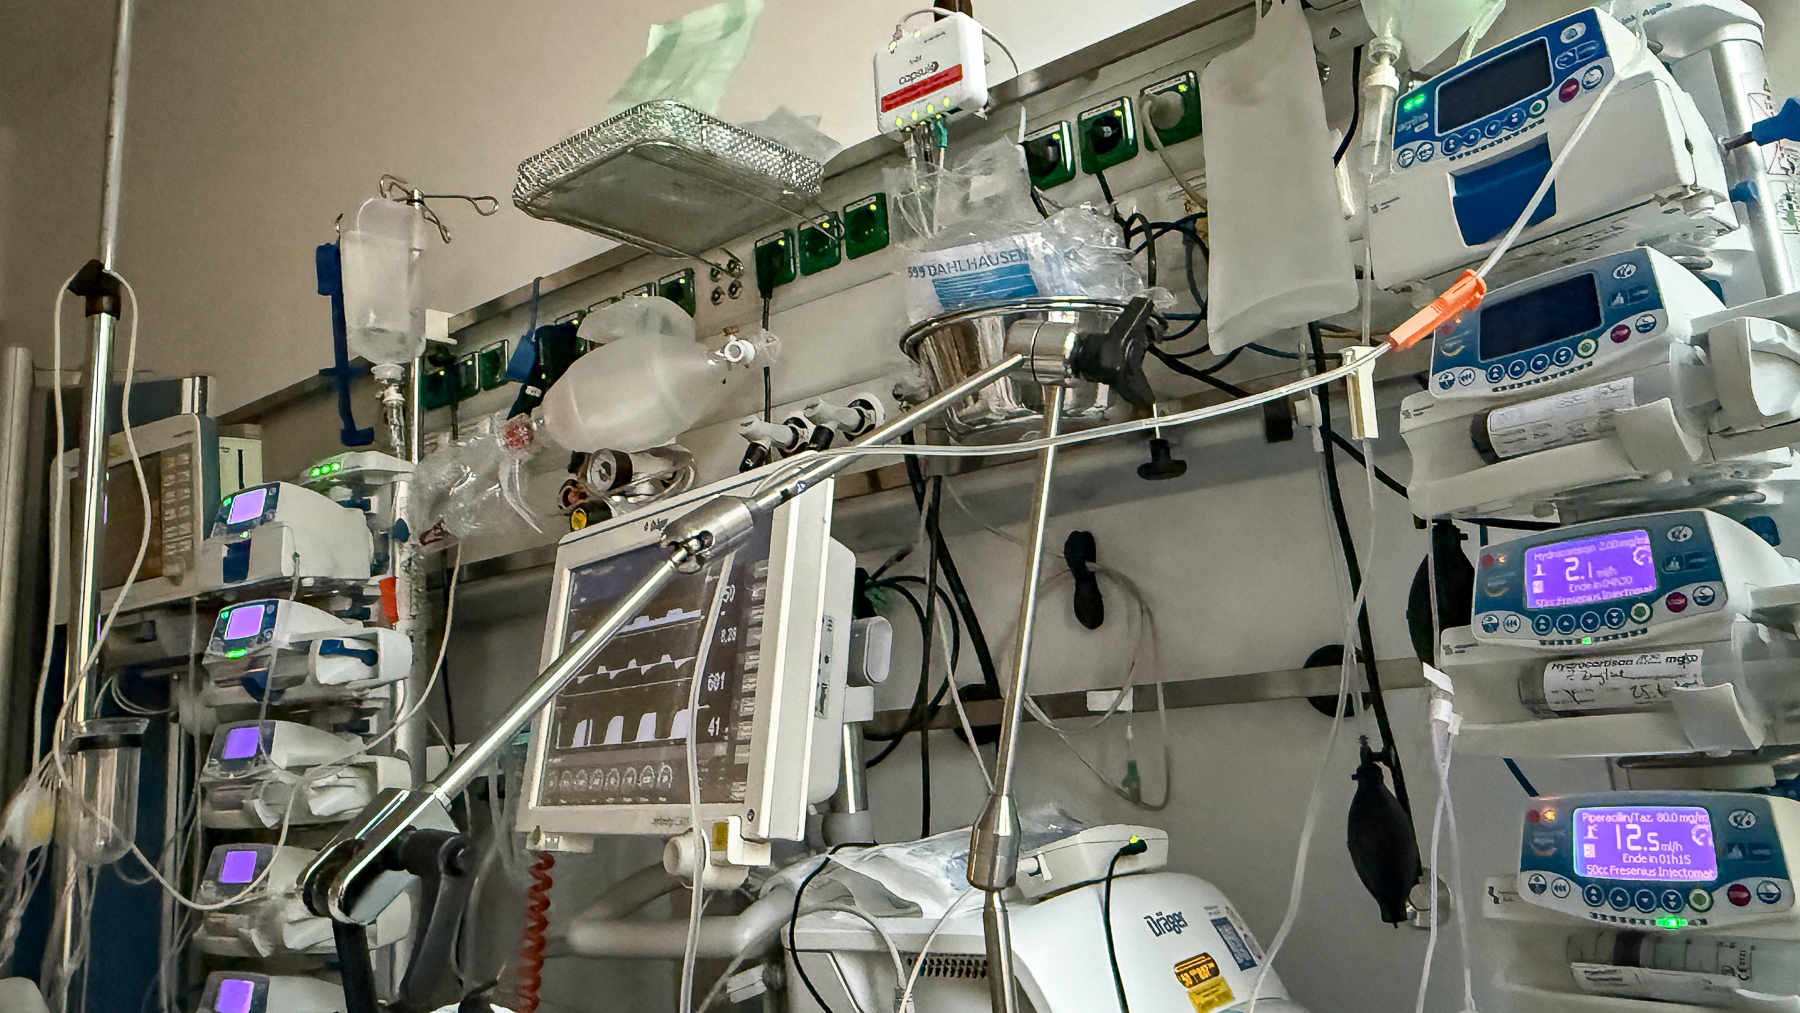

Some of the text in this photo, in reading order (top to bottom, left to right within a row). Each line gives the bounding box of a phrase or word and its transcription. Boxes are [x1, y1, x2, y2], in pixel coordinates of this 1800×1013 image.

[927, 248, 1029, 277] DAHLHAUSEN
[1564, 556, 1593, 581] 2.1
[1656, 811, 1677, 823] 80.0
[1615, 823, 1683, 853] 12.5 ml/h
[1586, 864, 1715, 879] 50cc Fresenius Injectomat
[1622, 853, 1692, 865] Ende in 01h15
[1143, 911, 1188, 938] Dräger
